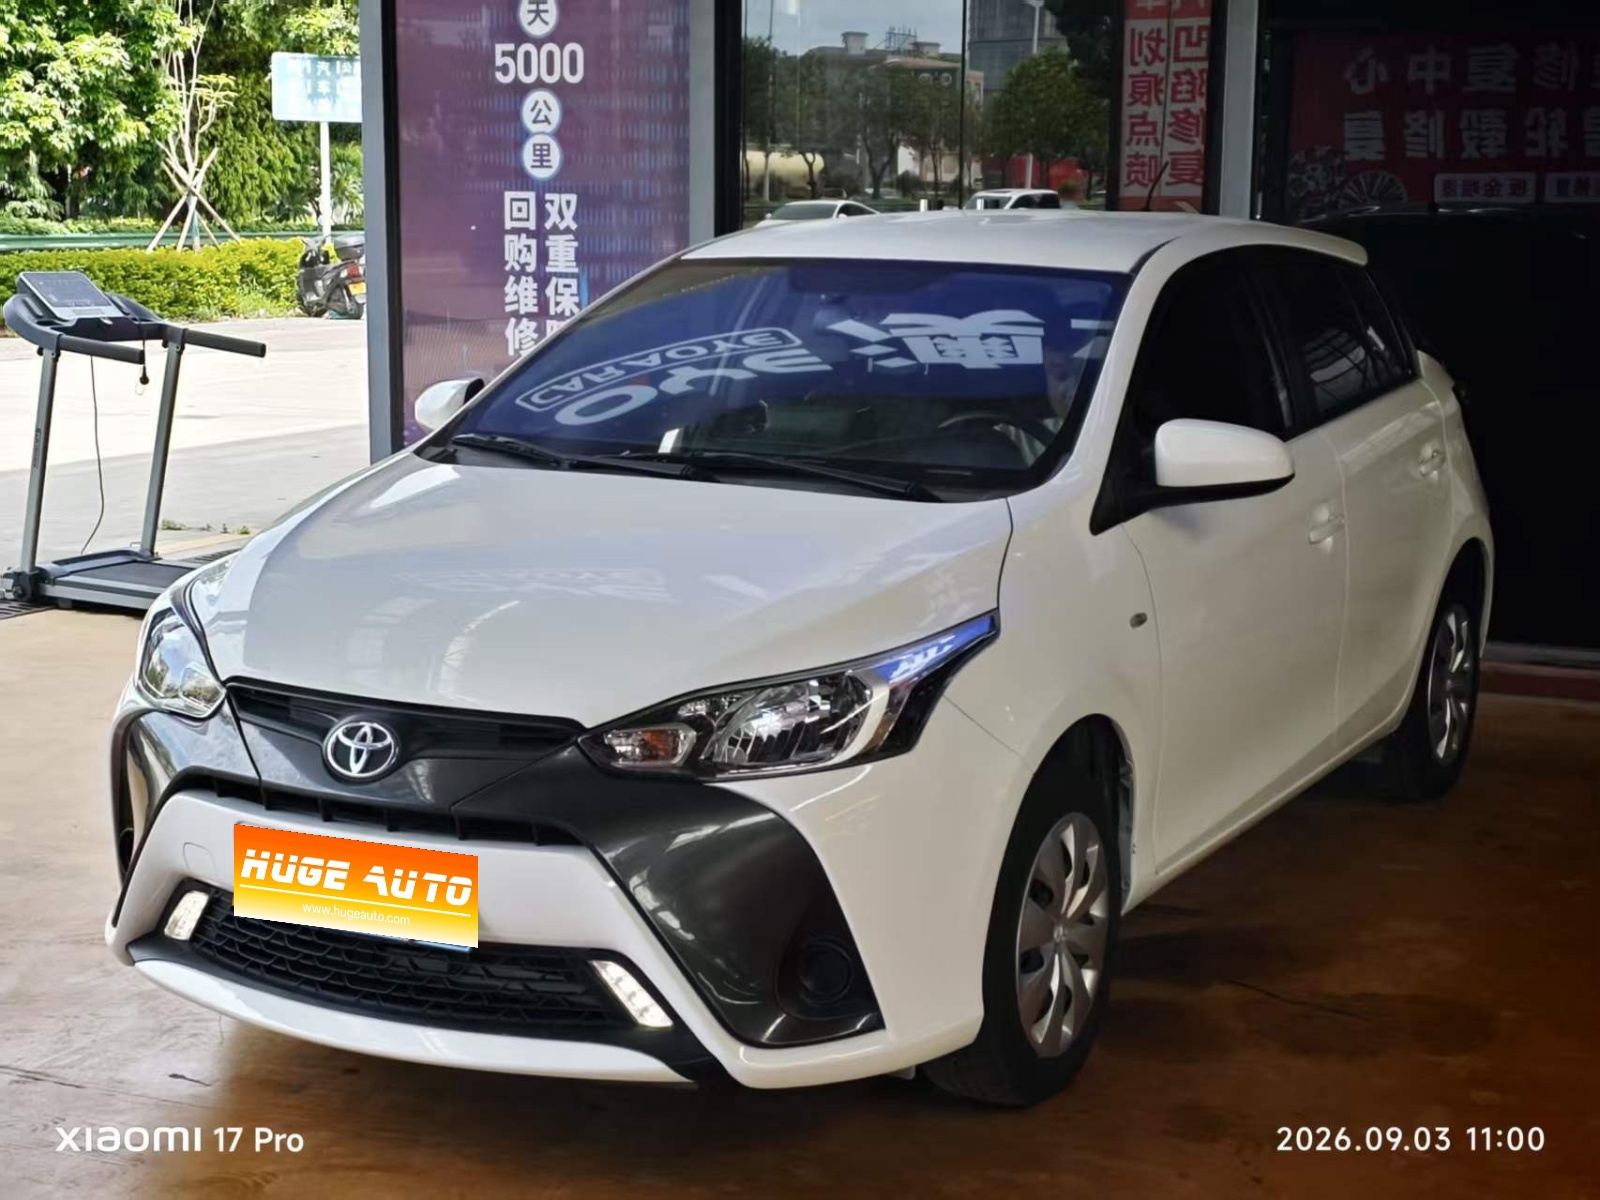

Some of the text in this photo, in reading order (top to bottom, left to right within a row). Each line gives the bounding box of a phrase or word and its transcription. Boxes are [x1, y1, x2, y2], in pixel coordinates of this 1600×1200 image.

[494, 42, 585, 85] 5000
[529, 98, 555, 170] 公里
[503, 190, 540, 358] 回购维修
